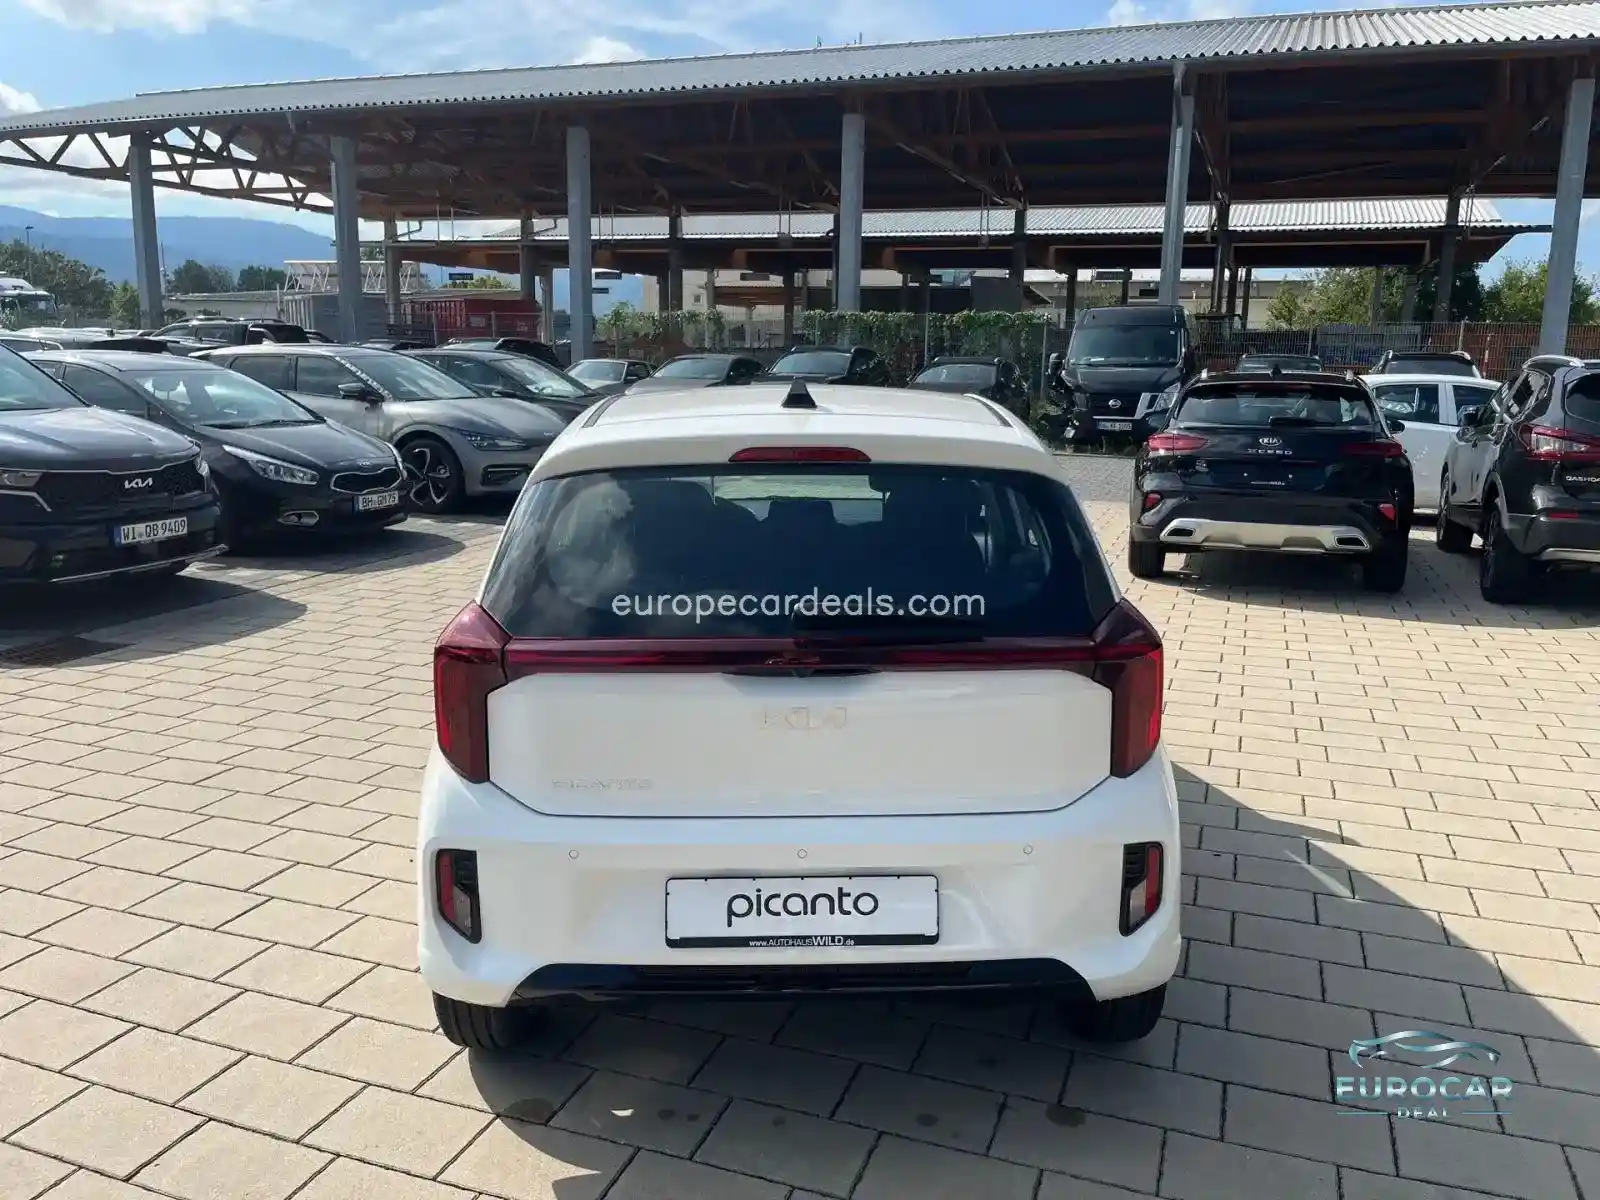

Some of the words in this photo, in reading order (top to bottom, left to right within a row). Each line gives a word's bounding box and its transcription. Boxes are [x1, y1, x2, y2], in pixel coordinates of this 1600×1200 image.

[122, 526, 136, 541] WI
[161, 518, 186, 536] 9409
[727, 887, 879, 928] picanto
[749, 936, 855, 947] www.AUTOHAUSWILD.de
